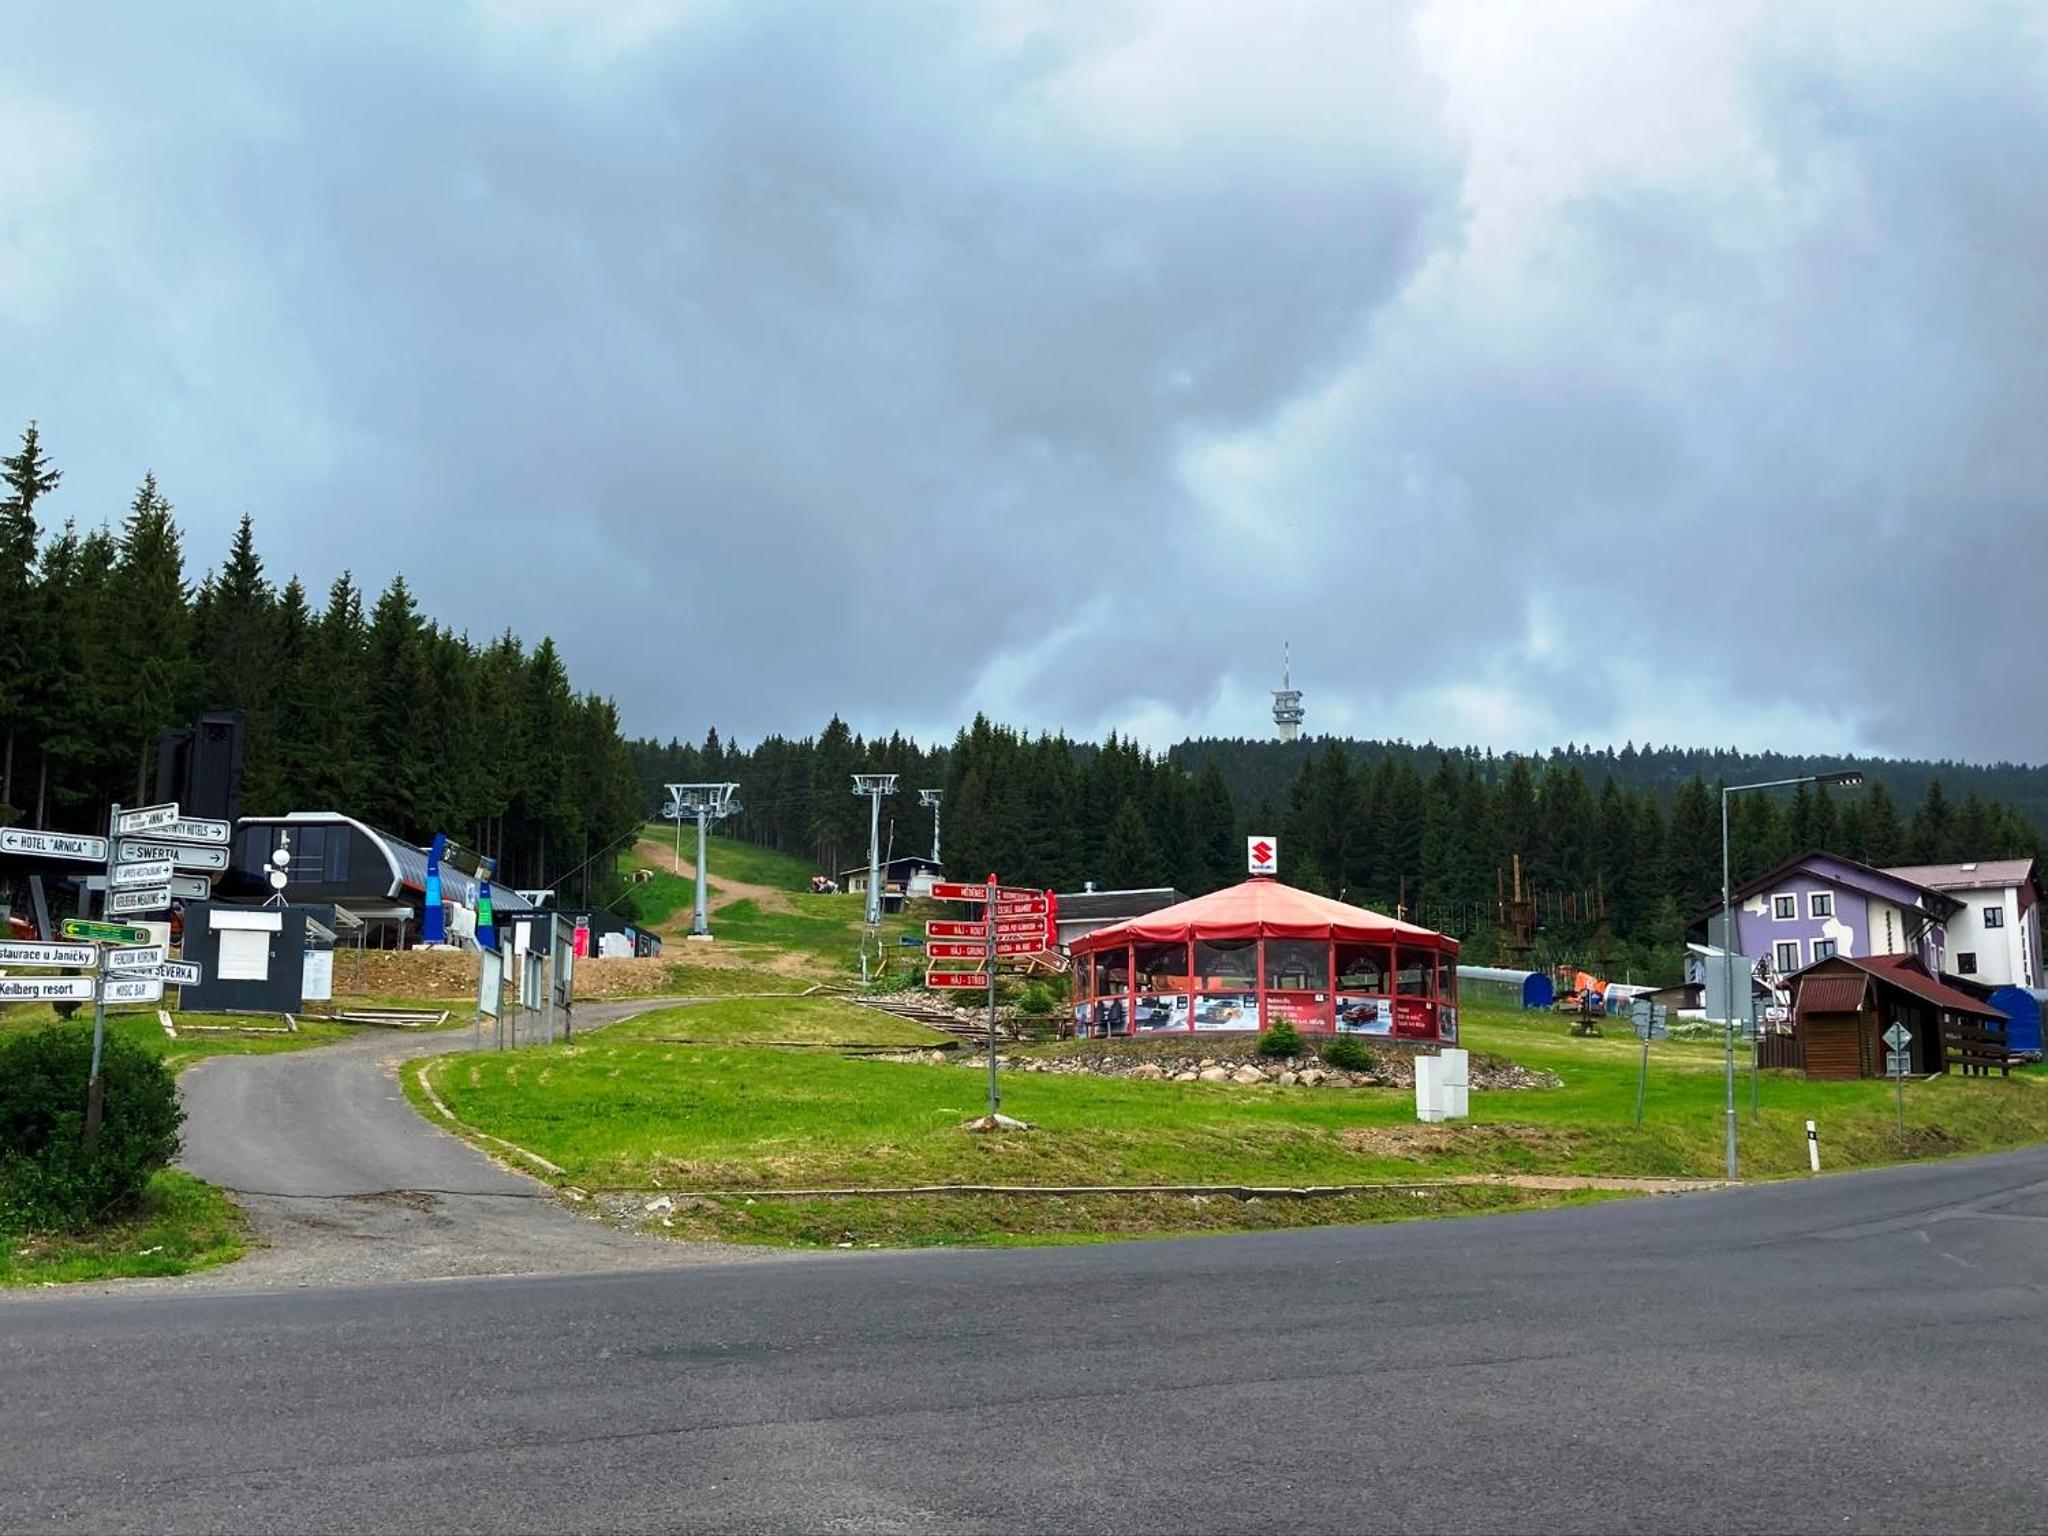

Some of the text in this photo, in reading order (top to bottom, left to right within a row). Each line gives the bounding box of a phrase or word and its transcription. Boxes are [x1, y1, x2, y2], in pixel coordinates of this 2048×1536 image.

[187, 823, 208, 837] HOTELS
[21, 835, 87, 854] HOTEL "ARNICA"
[137, 846, 180, 861] SWERTIA
[44, 952, 50, 960] u
[52, 948, 91, 964] Janičky
[0, 982, 73, 998] Keilberg resort
[135, 984, 146, 995] BAR
